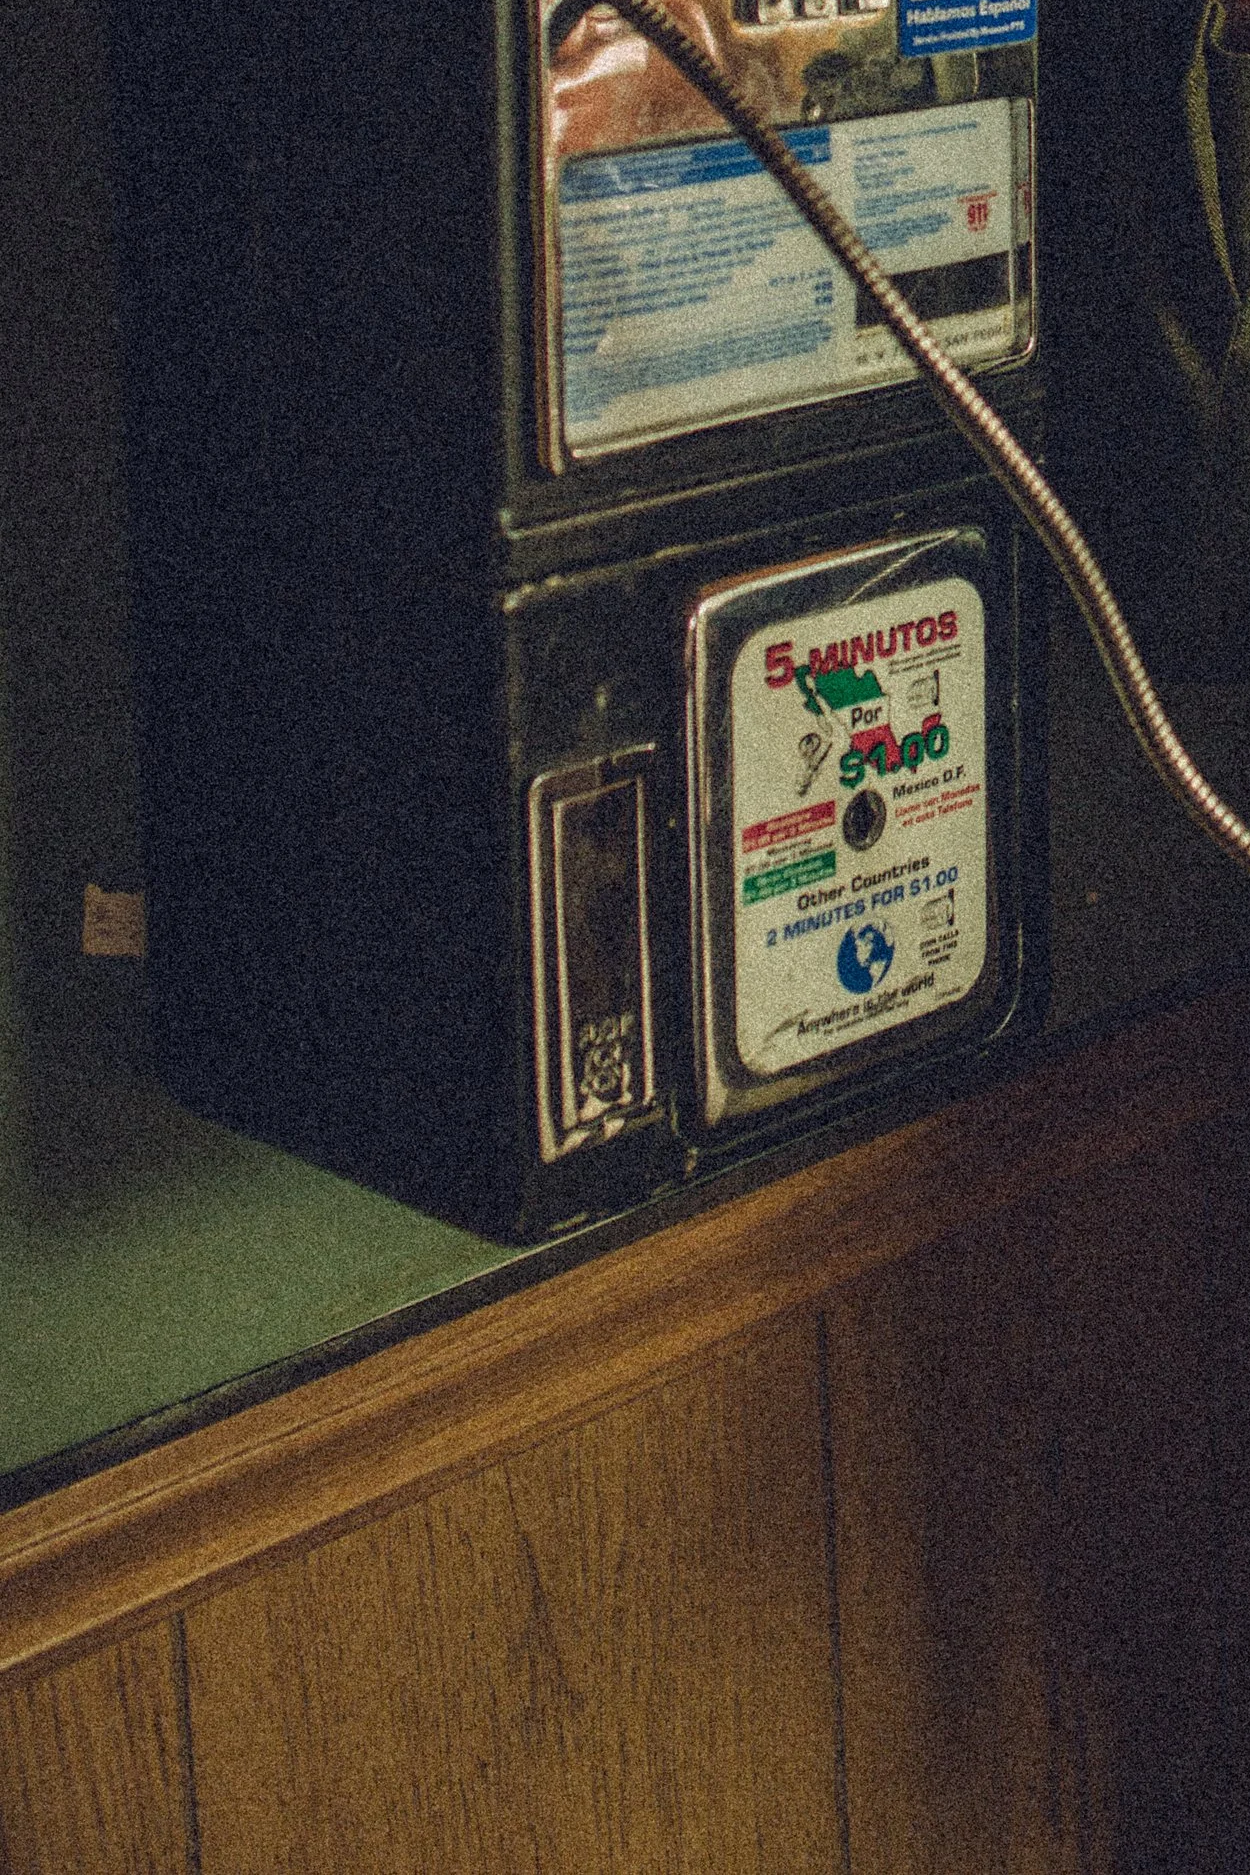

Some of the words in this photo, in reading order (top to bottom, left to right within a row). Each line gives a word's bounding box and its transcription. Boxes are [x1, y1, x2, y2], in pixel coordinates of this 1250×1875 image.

[906, 6, 976, 28] Hablamos
[966, 203, 989, 226] 911
[764, 639, 795, 690] 5
[809, 609, 959, 680] MINUTOS
[851, 705, 883, 729] Por
[839, 723, 950, 790] $1.00
[893, 776, 939, 800] Mexico
[943, 764, 967, 783] D.F.
[766, 928, 777, 948] 2
[783, 898, 866, 941] MINUTES
[871, 884, 905, 910] FOR
[909, 865, 959, 896] $1.00
[797, 882, 846, 911] Other
[851, 855, 931, 893] Countries
[797, 1003, 860, 1037] Anywhere
[901, 971, 935, 998] world
